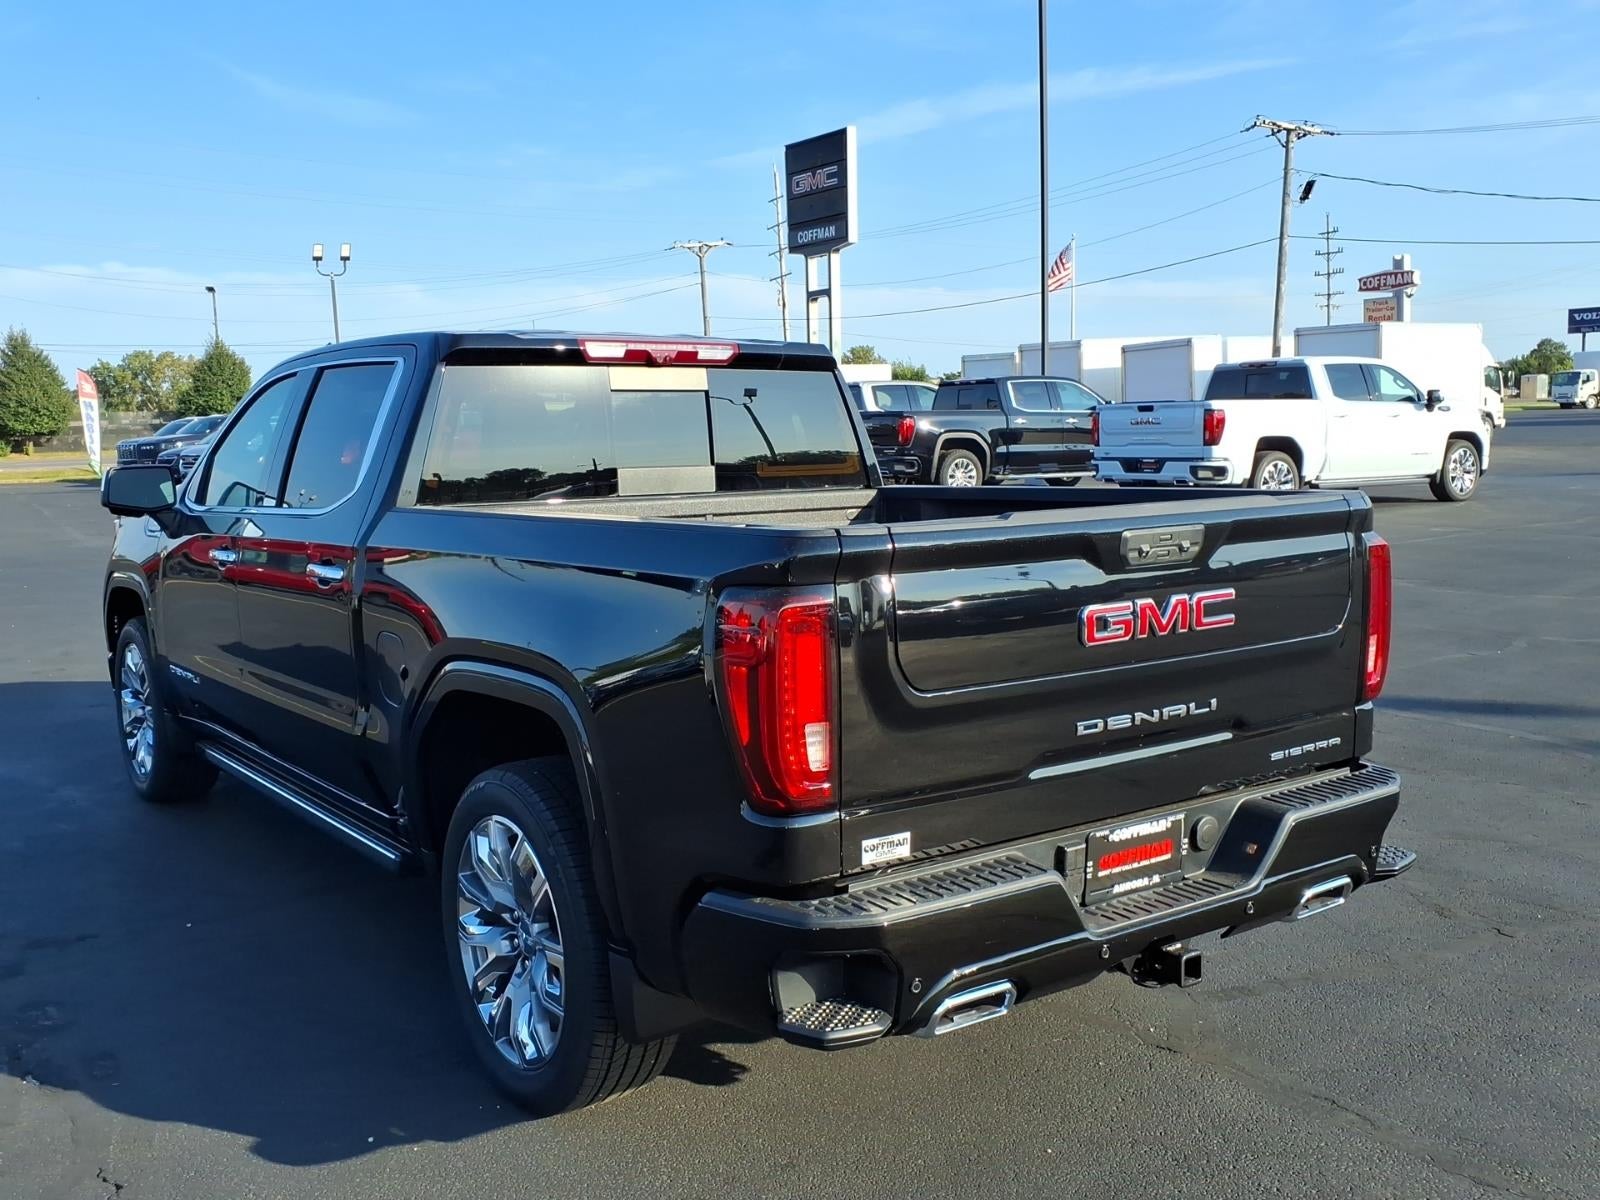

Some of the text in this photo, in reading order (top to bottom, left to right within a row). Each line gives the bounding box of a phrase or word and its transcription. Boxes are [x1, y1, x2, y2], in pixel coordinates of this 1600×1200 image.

[792, 165, 838, 195] GMC
[797, 225, 836, 243] COFFMAN
[1360, 272, 1411, 289] COFFMAN
[1367, 313, 1394, 322] Rental
[1573, 311, 1600, 321] VOL
[1130, 417, 1162, 426] GMC
[1078, 587, 1236, 648] GMC
[1076, 697, 1218, 737] DENALI
[1270, 736, 1342, 761] SIERRA
[864, 837, 908, 853] COFFMAN
